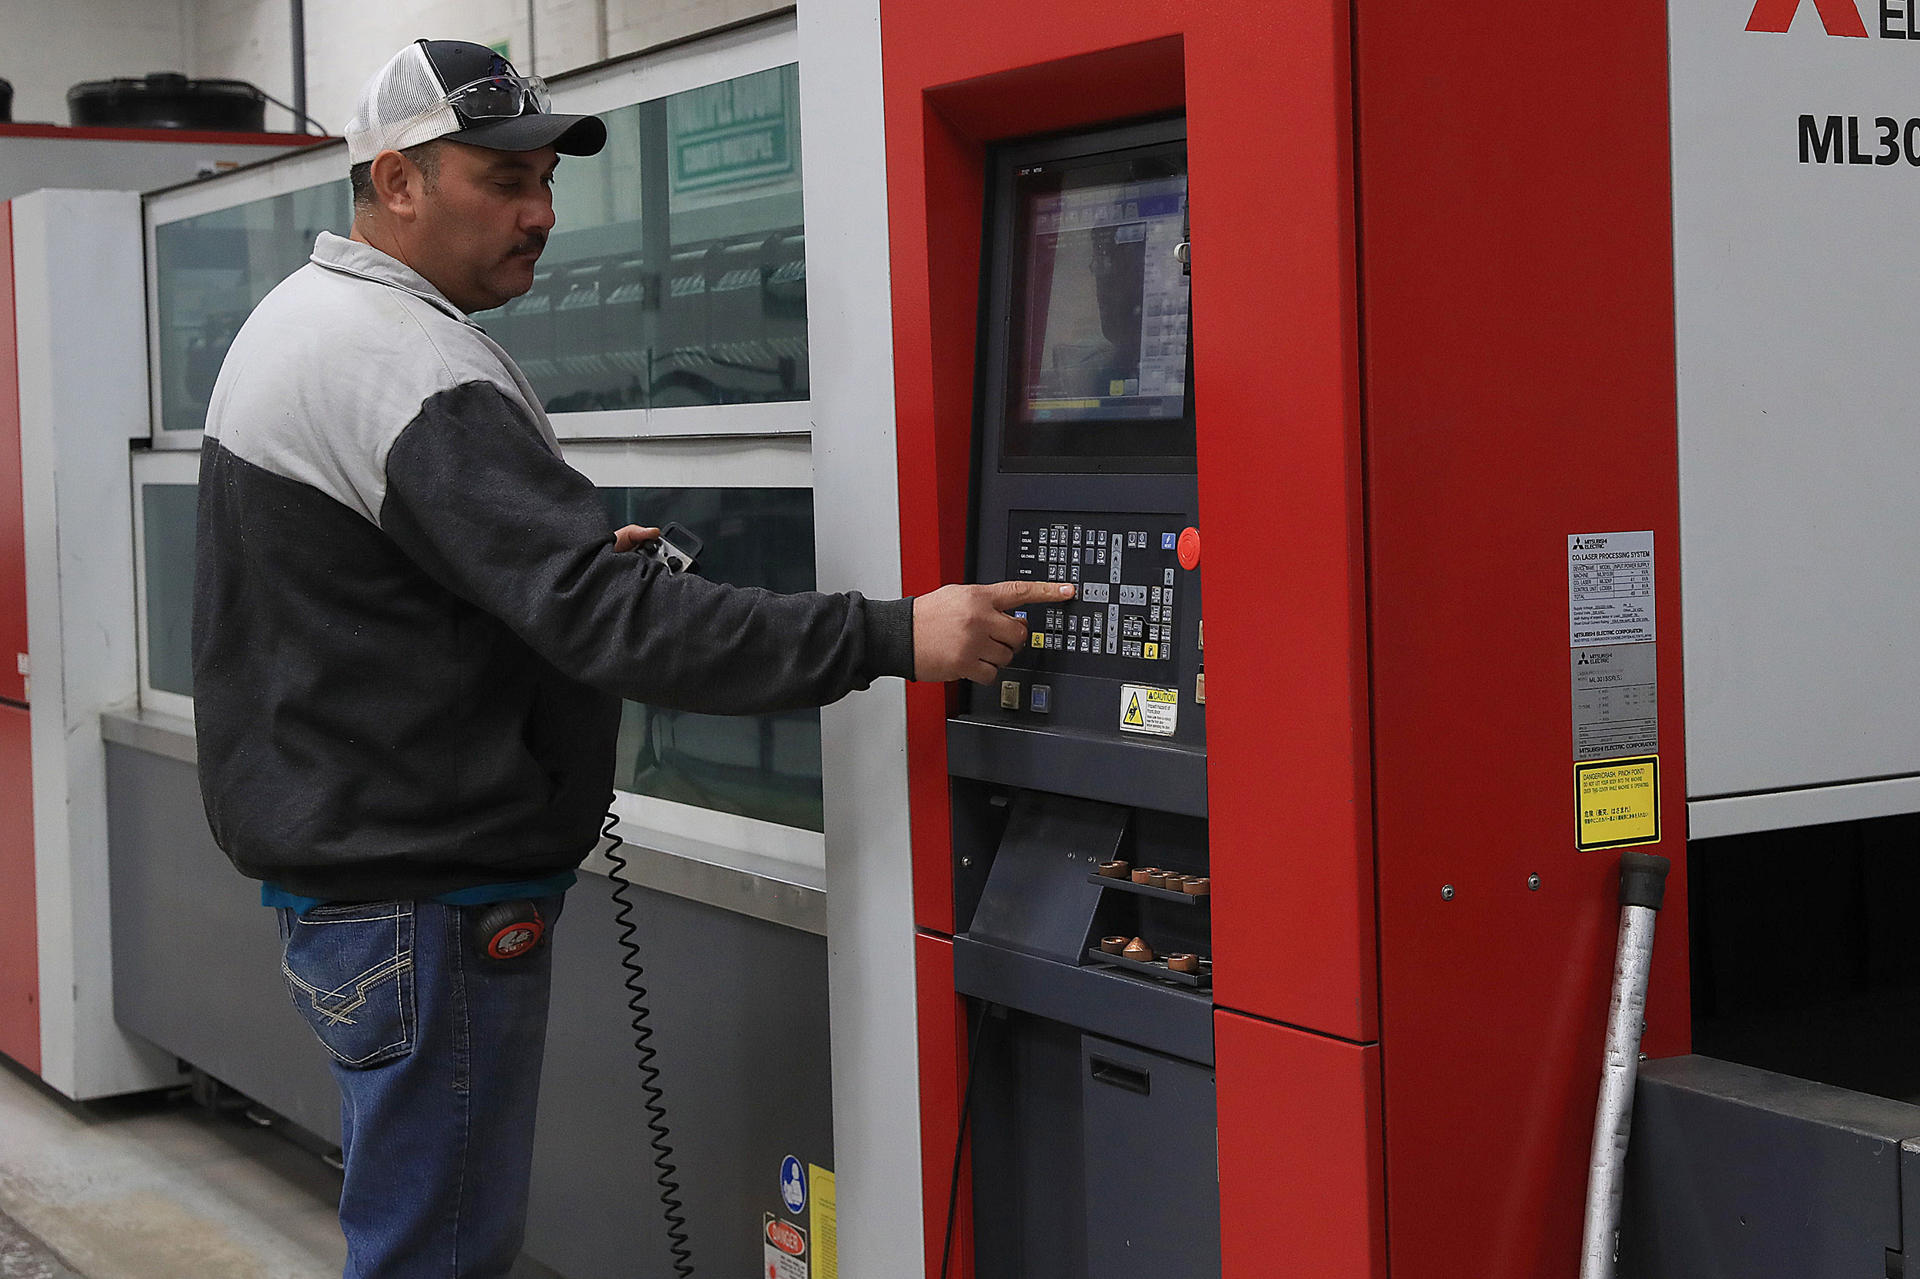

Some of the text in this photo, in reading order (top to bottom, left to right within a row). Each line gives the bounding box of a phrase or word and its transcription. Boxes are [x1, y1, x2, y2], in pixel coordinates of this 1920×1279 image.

[1798, 115, 1920, 167] ML30
[1154, 692, 1175, 702] CAUTION
[772, 1223, 799, 1252] DANGER
